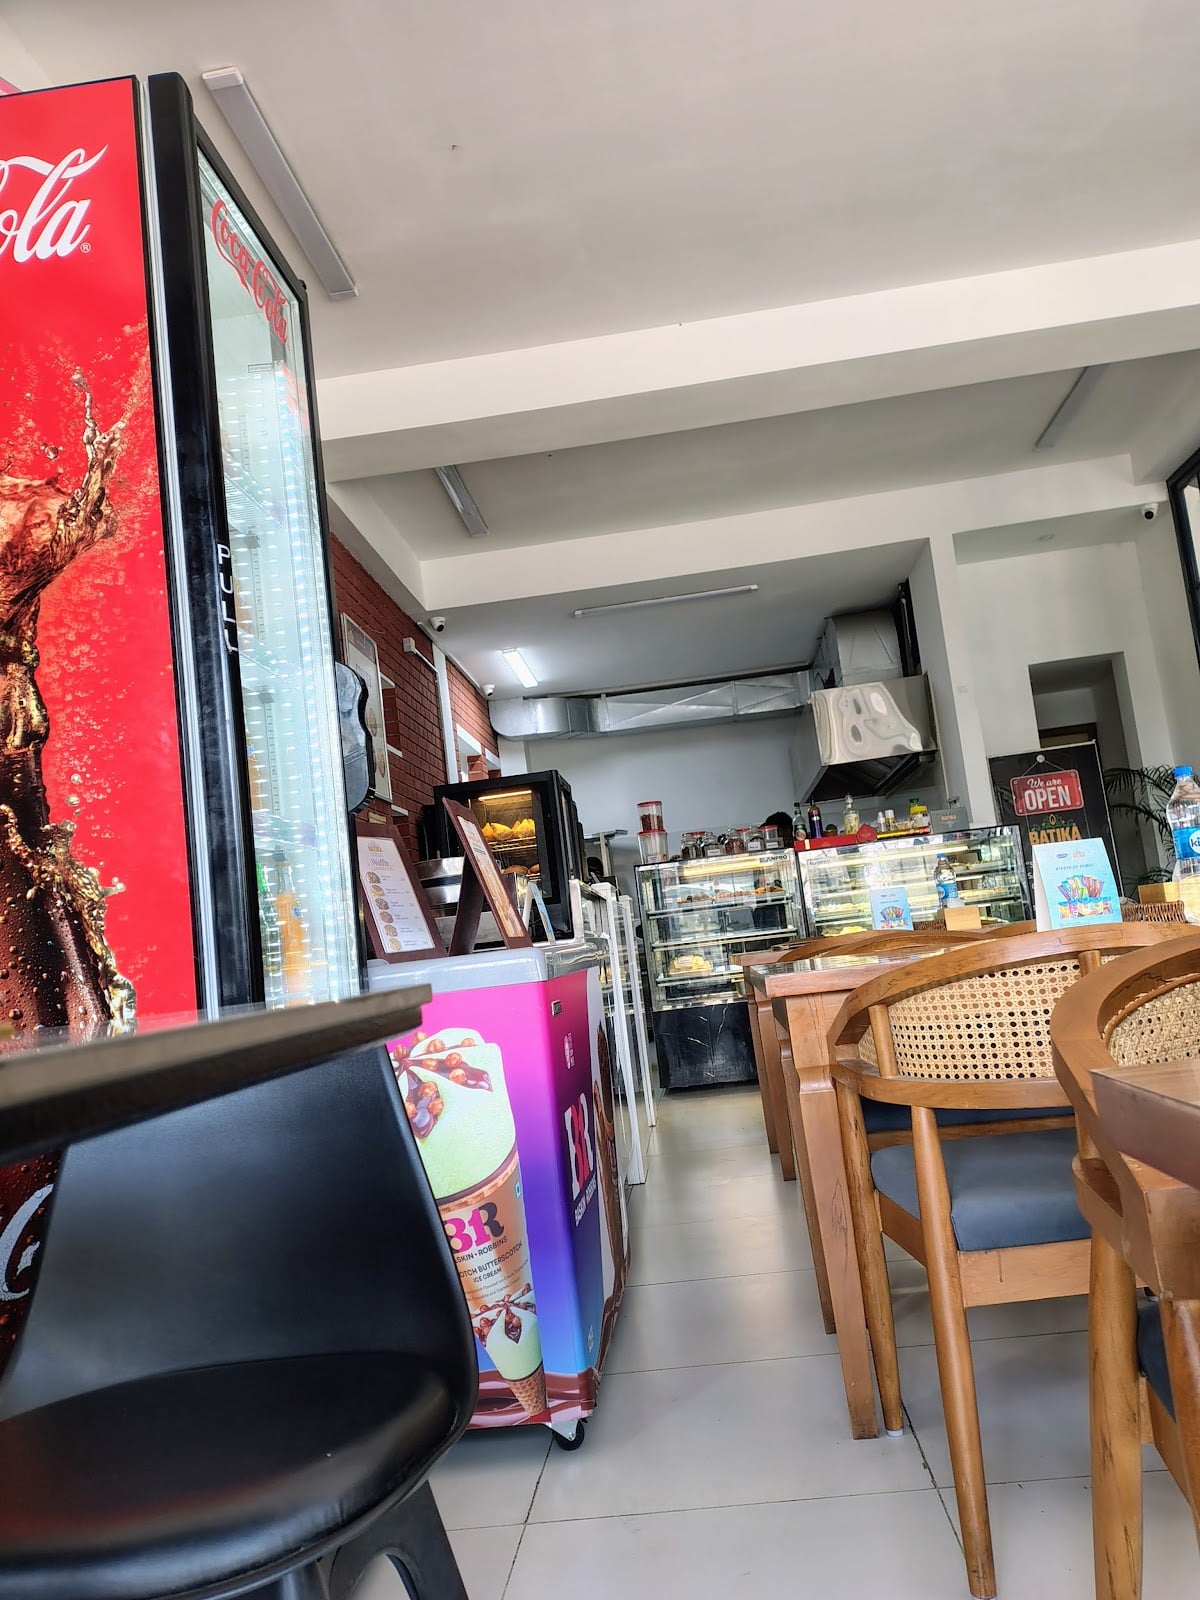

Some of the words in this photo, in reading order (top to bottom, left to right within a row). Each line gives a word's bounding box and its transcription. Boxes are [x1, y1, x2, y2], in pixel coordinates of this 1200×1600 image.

[0, 144, 109, 263] ola
[217, 543, 239, 654] PULL
[1027, 779, 1044, 788] We
[1046, 778, 1062, 786] are
[1024, 785, 1071, 811] OPEN
[1029, 826, 1081, 845] BATIKA
[456, 1252, 475, 1264] SKIN
[478, 1235, 508, 1257] ROBBINS
[460, 1267, 478, 1278] OTCH
[478, 1242, 523, 1273] BUTTERSCOTCH
[483, 1267, 503, 1281] CREAM
